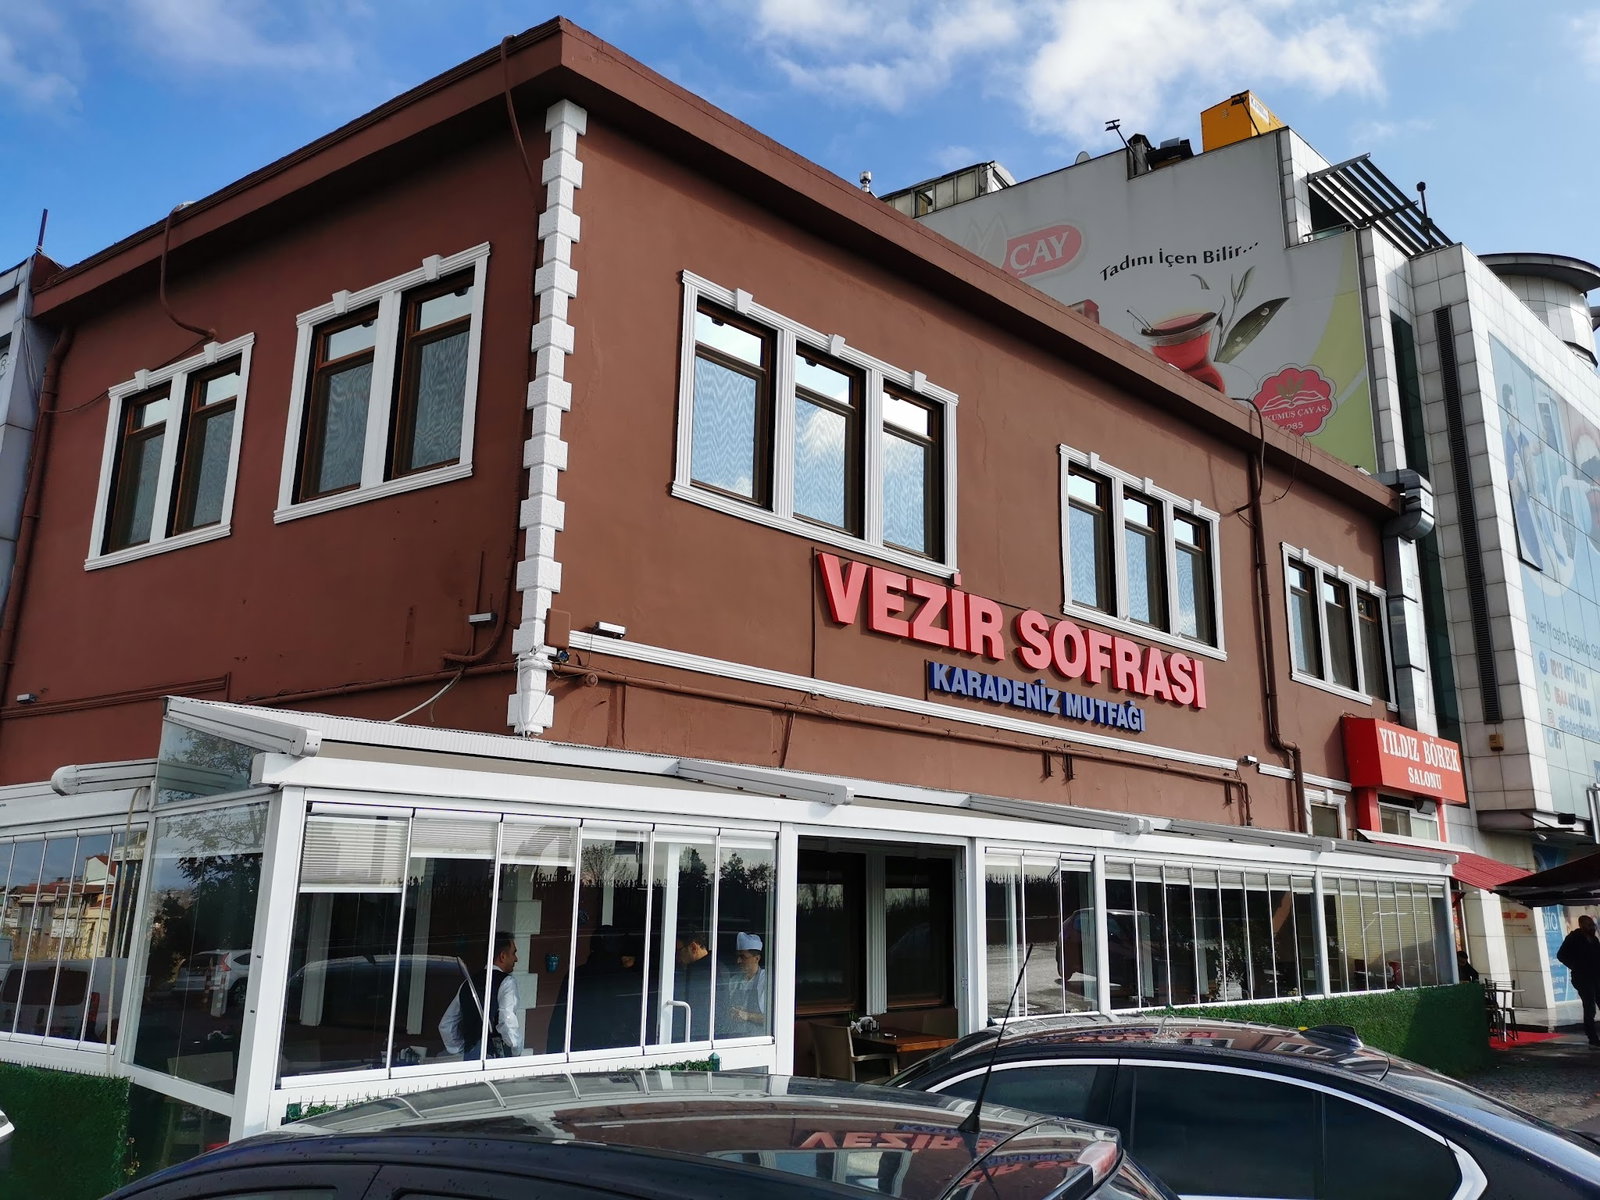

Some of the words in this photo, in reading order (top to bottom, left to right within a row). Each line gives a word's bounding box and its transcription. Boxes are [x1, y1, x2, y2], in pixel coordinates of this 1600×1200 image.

[1010, 232, 1069, 277] ÇAY
[1100, 255, 1153, 281] Tadını
[1158, 248, 1197, 267] İçen
[1297, 406, 1315, 417] ÇAY
[817, 552, 1005, 661] VEZİR
[1016, 610, 1207, 709] SOFRASI
[928, 661, 1060, 713] KARADENİZ
[1062, 691, 1145, 732] MUTFAĞI
[1379, 727, 1420, 762] YILDIZ
[1422, 737, 1461, 773] BÖREK
[1408, 767, 1442, 790] SALONU
